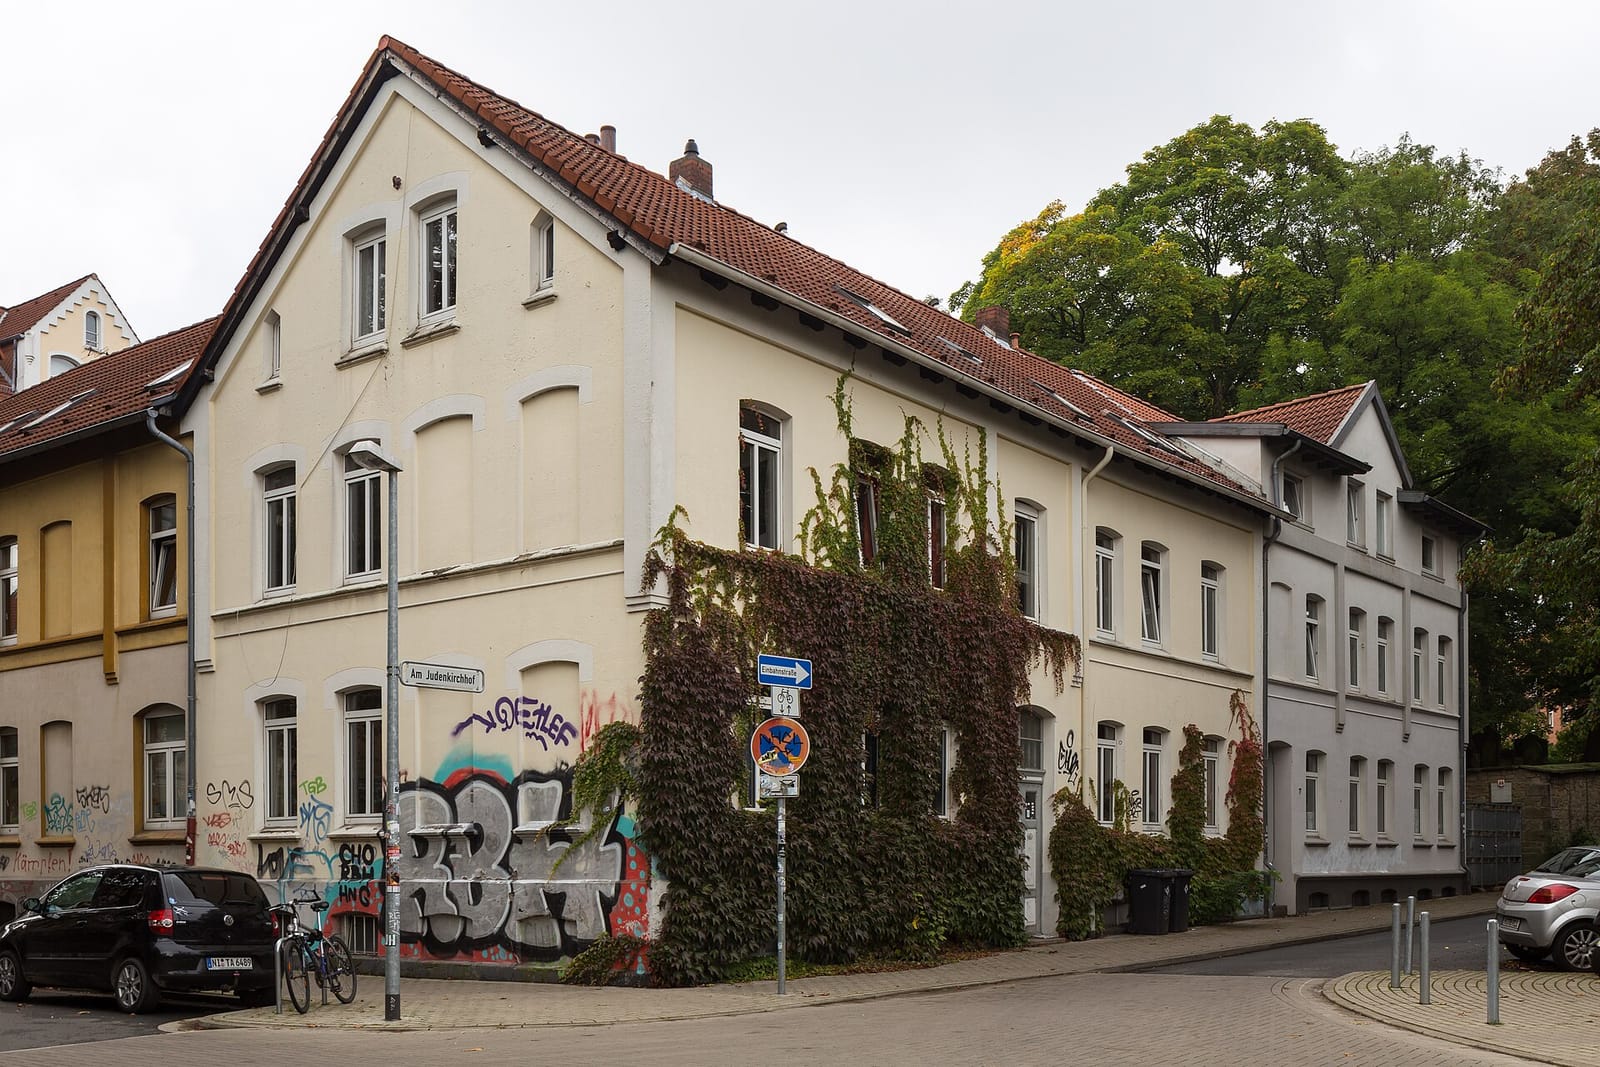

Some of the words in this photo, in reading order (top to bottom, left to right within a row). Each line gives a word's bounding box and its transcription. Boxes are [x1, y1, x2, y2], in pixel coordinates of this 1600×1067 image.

[410, 668, 423, 679] Am
[425, 669, 476, 685] Judenkirchhof
[762, 666, 797, 677] Einbahnstraße
[206, 780, 254, 812] SMS
[339, 843, 375, 866] CHO
